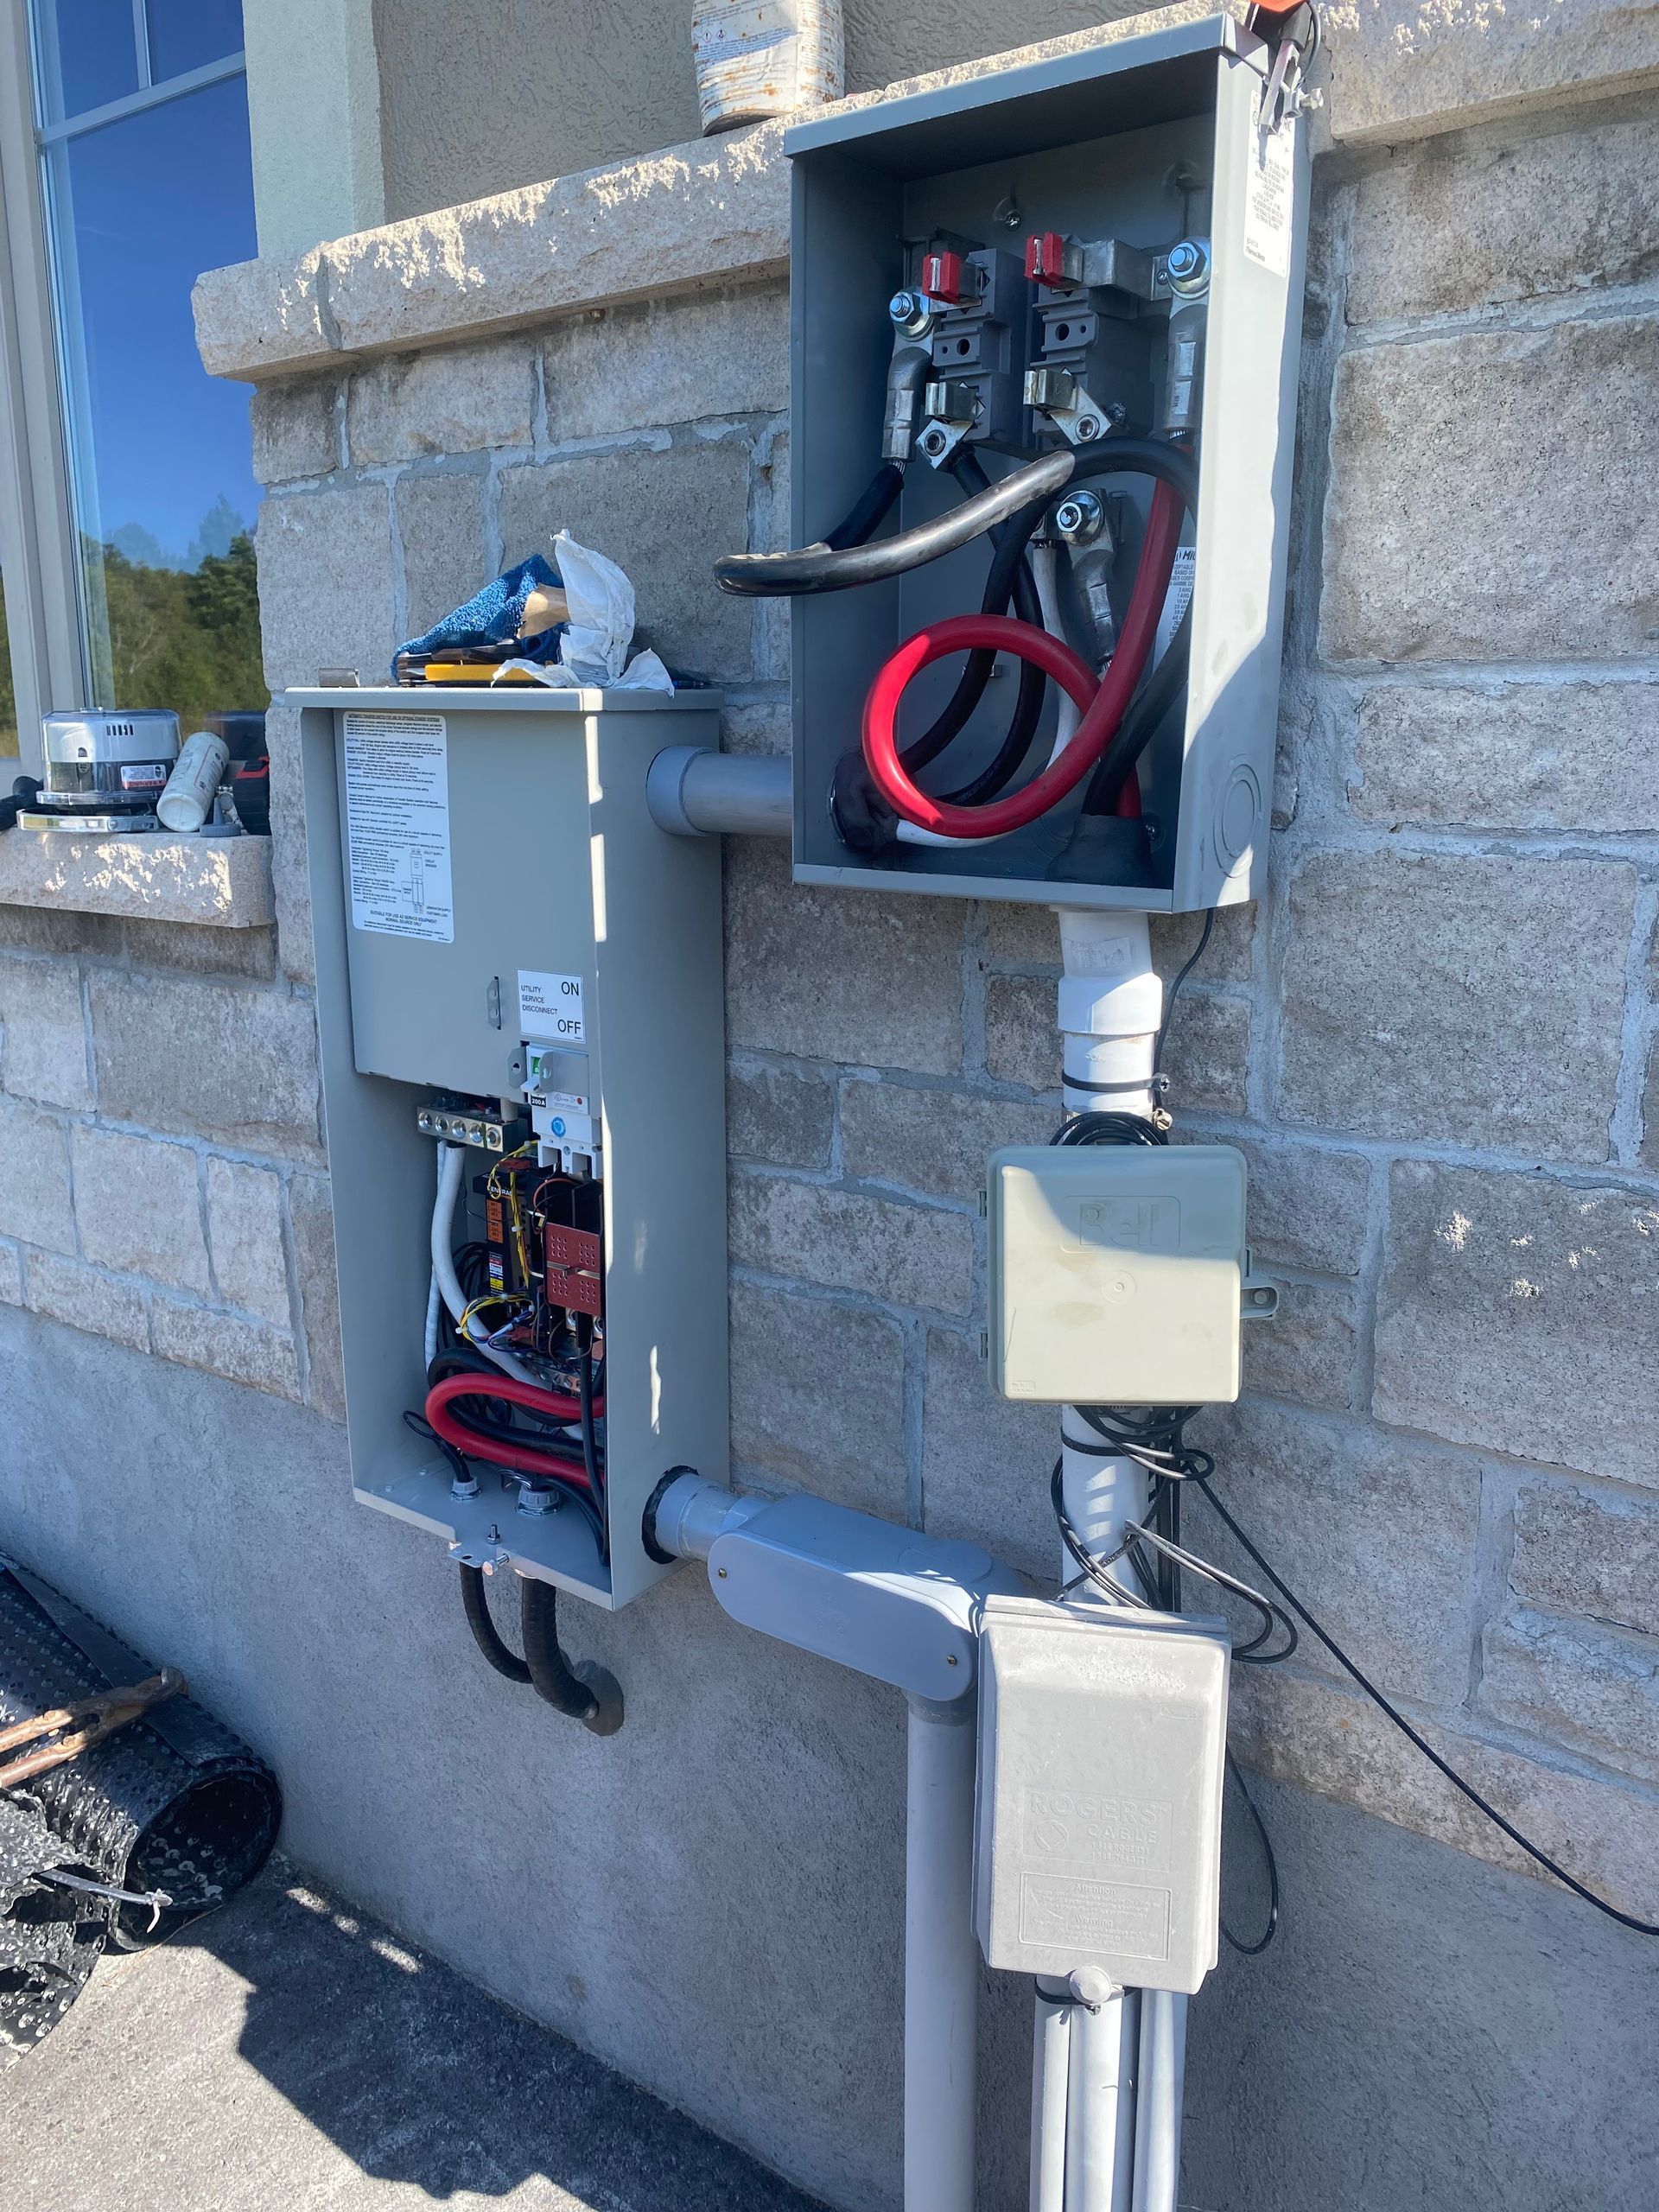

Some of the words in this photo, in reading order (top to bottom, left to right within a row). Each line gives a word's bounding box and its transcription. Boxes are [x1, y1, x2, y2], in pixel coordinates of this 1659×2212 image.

[561, 982, 579, 996] ON
[522, 995, 544, 1003] SERVICE
[522, 1004, 558, 1014] DISCONNECT
[557, 1019, 582, 1034] OFF
[1030, 1791, 1158, 1825] ROGERS
[1087, 1823, 1158, 1844] CABLE
[1077, 1883, 1116, 1896] Attention
[1075, 1914, 1113, 1928] Warning
